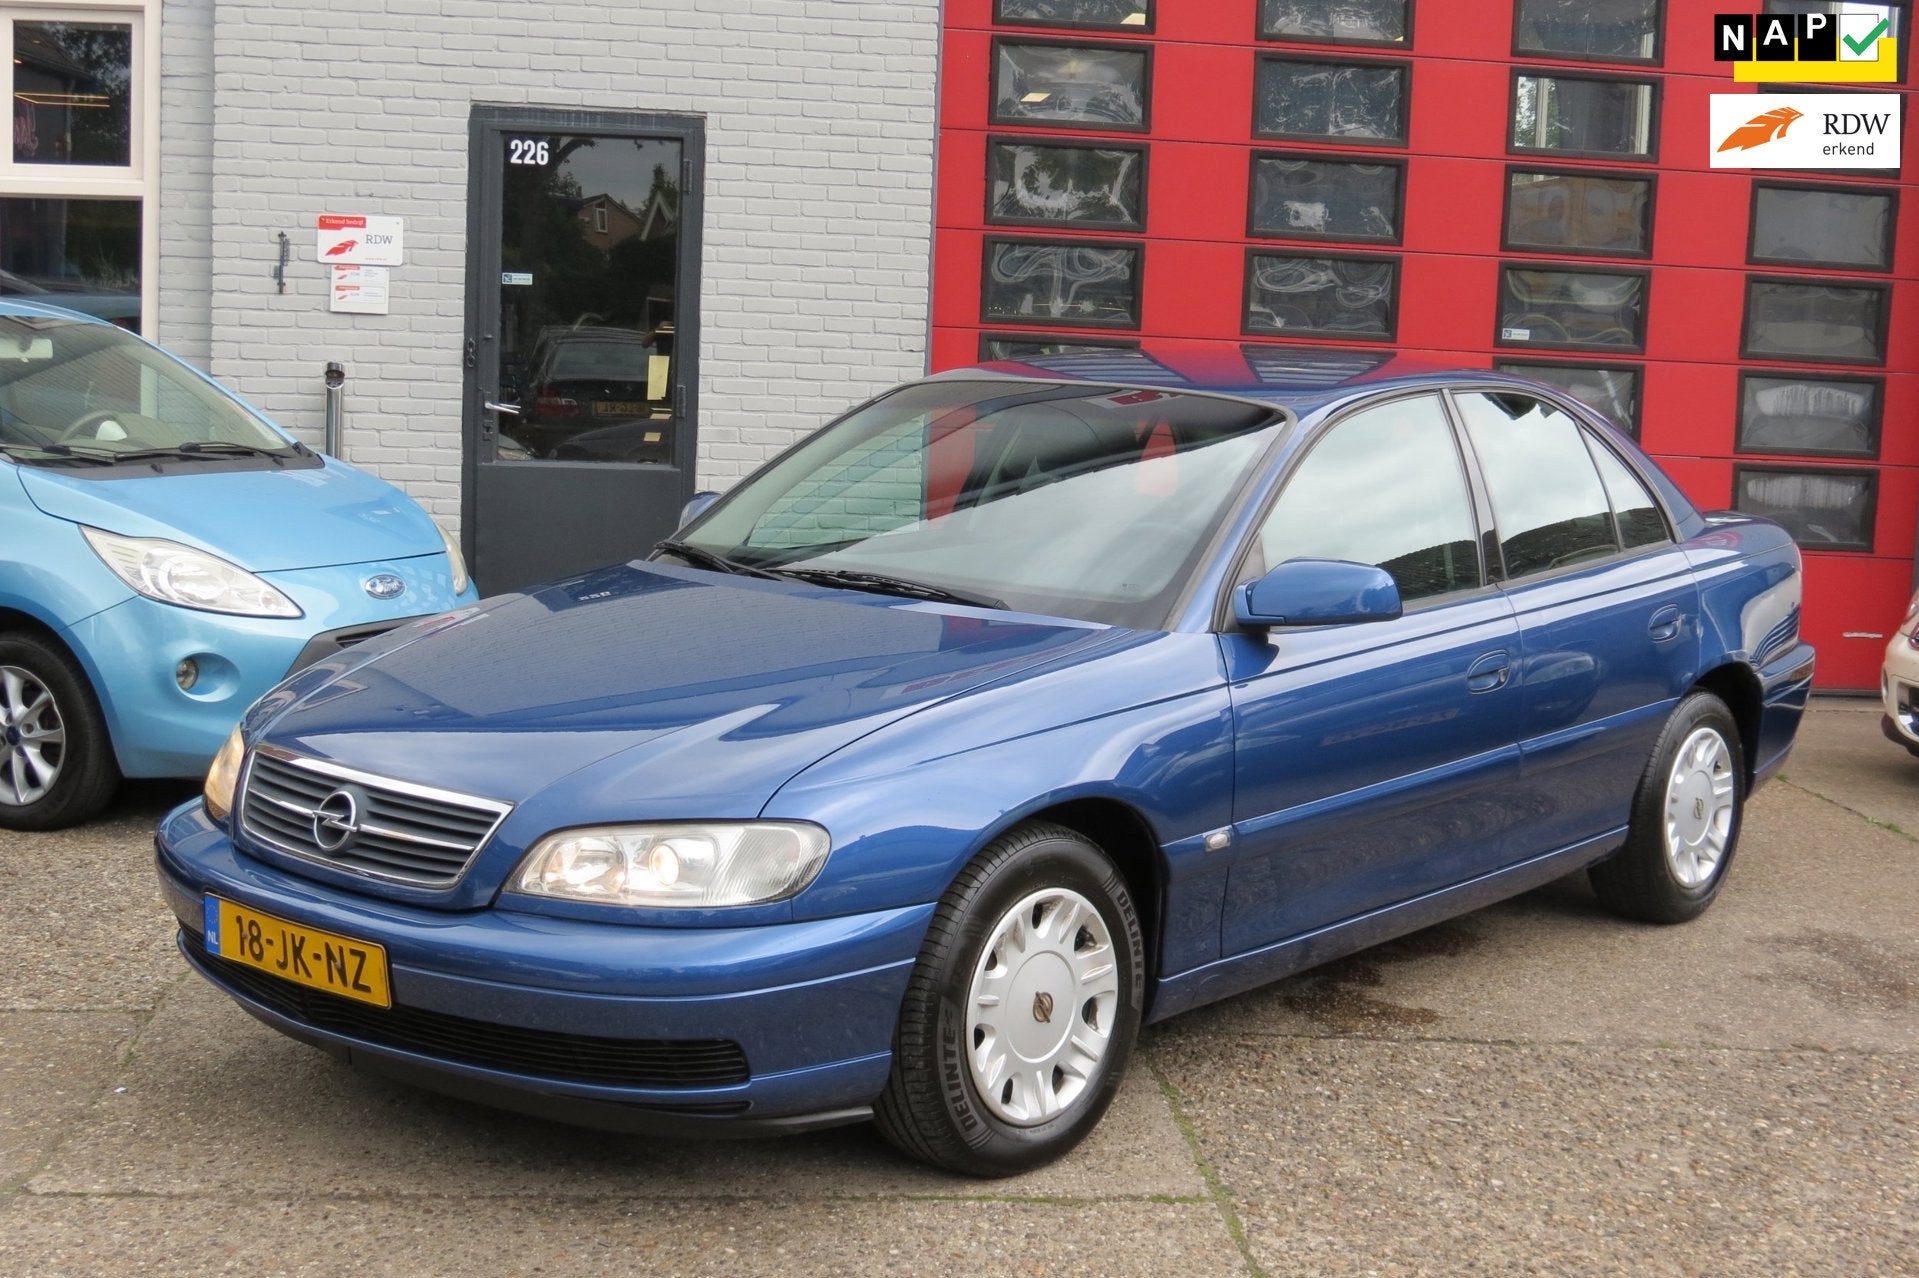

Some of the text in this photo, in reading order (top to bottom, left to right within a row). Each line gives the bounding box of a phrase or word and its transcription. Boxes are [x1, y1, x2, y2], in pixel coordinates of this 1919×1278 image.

[510, 139, 549, 166] 226
[365, 234, 393, 245] RDW
[207, 930, 219, 946] NL
[235, 914, 373, 994] 18-JK-NZ
[942, 1027, 979, 1132] DELINTE
